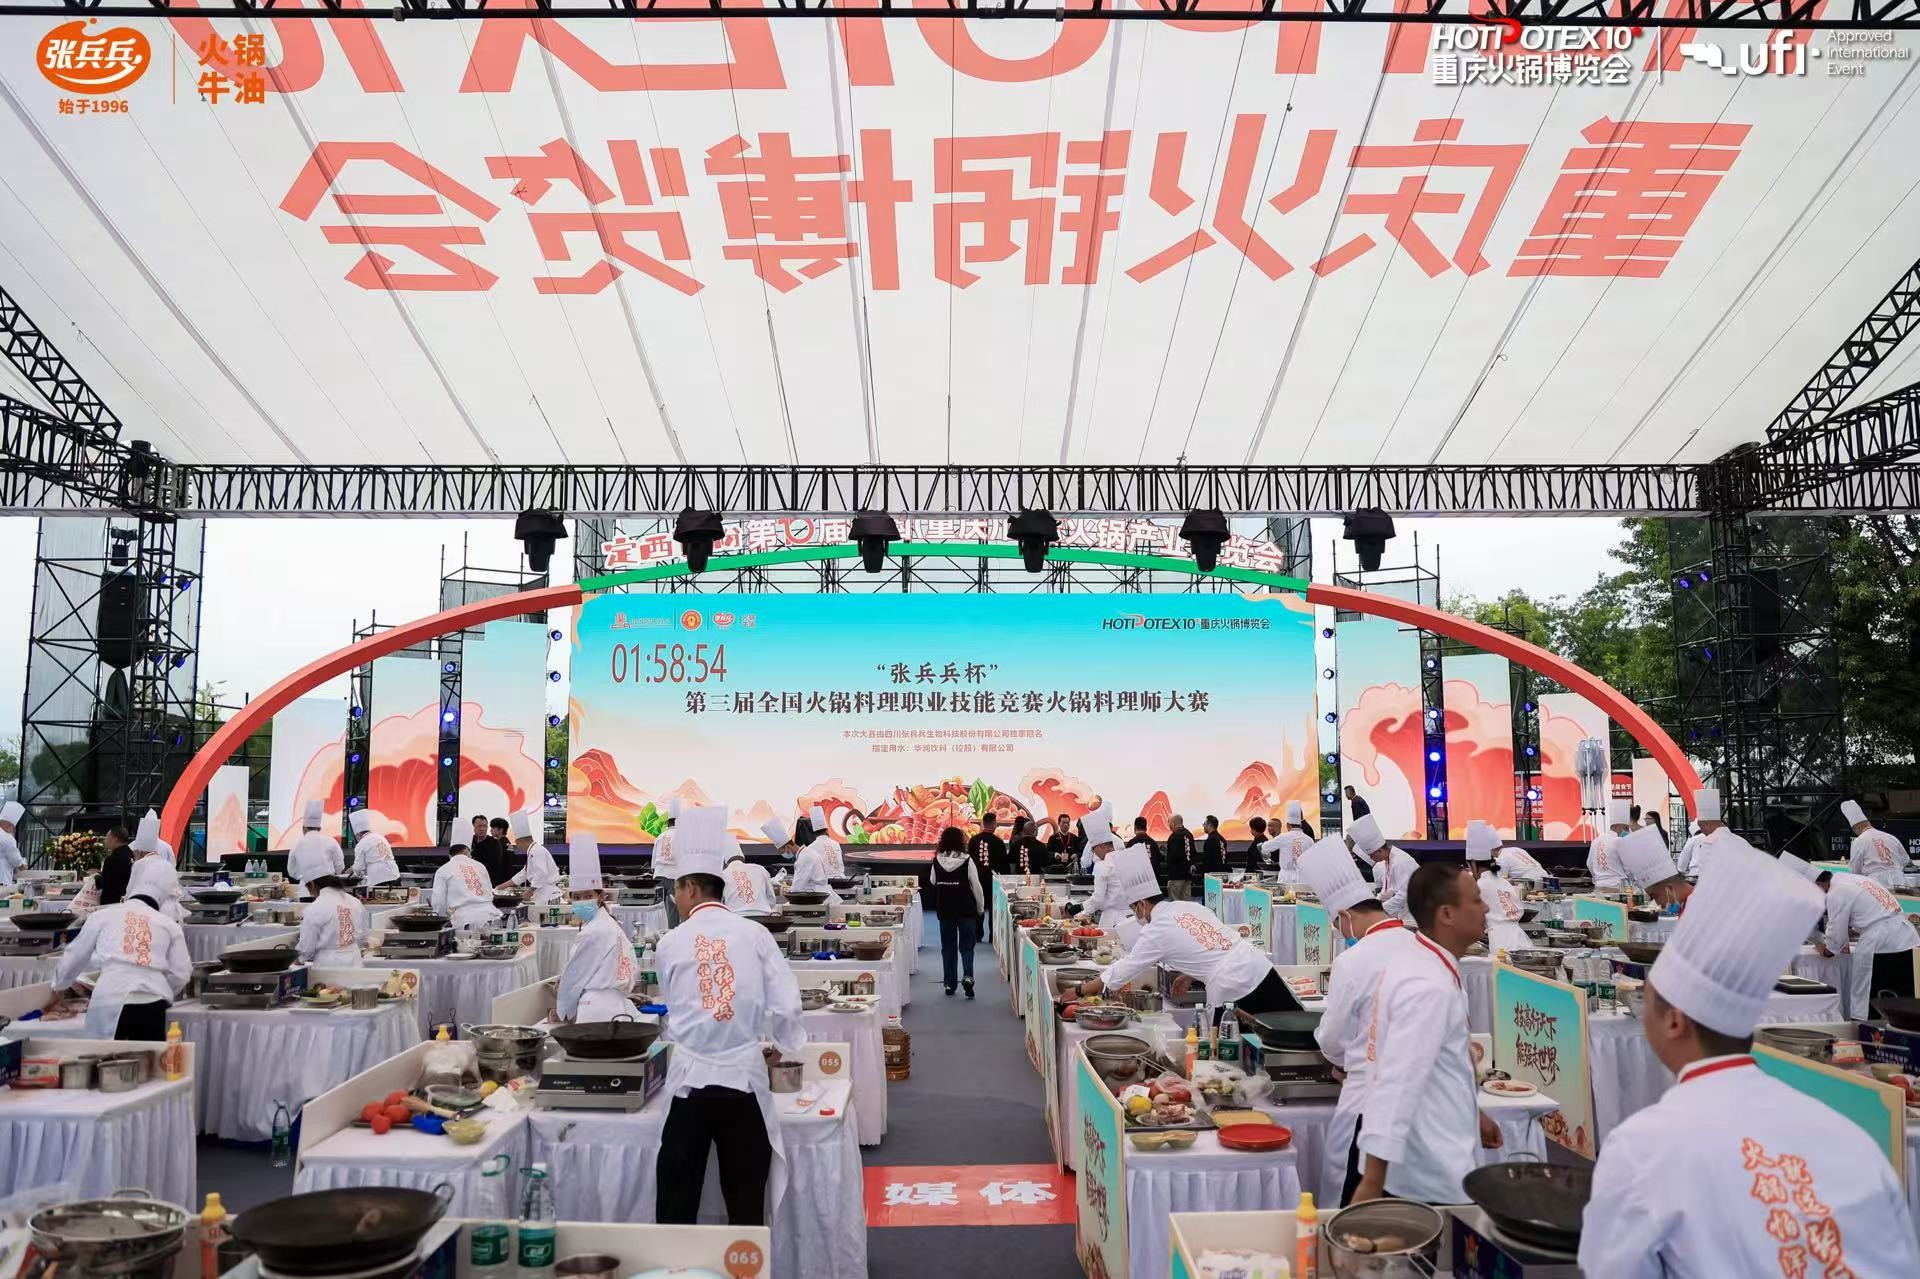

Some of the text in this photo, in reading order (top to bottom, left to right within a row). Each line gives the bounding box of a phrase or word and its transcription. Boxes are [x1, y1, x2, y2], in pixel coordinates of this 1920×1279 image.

[1200, 617, 1271, 630] 重庆火锅博览会
[611, 643, 728, 684] 01:58:54
[684, 690, 1210, 715] 第三届全国火锅料理职业技能竞赛火锅料理师大赛
[821, 1058, 839, 1066] 055
[882, 1180, 1058, 1206] 媒体
[729, 1253, 758, 1265] 065
